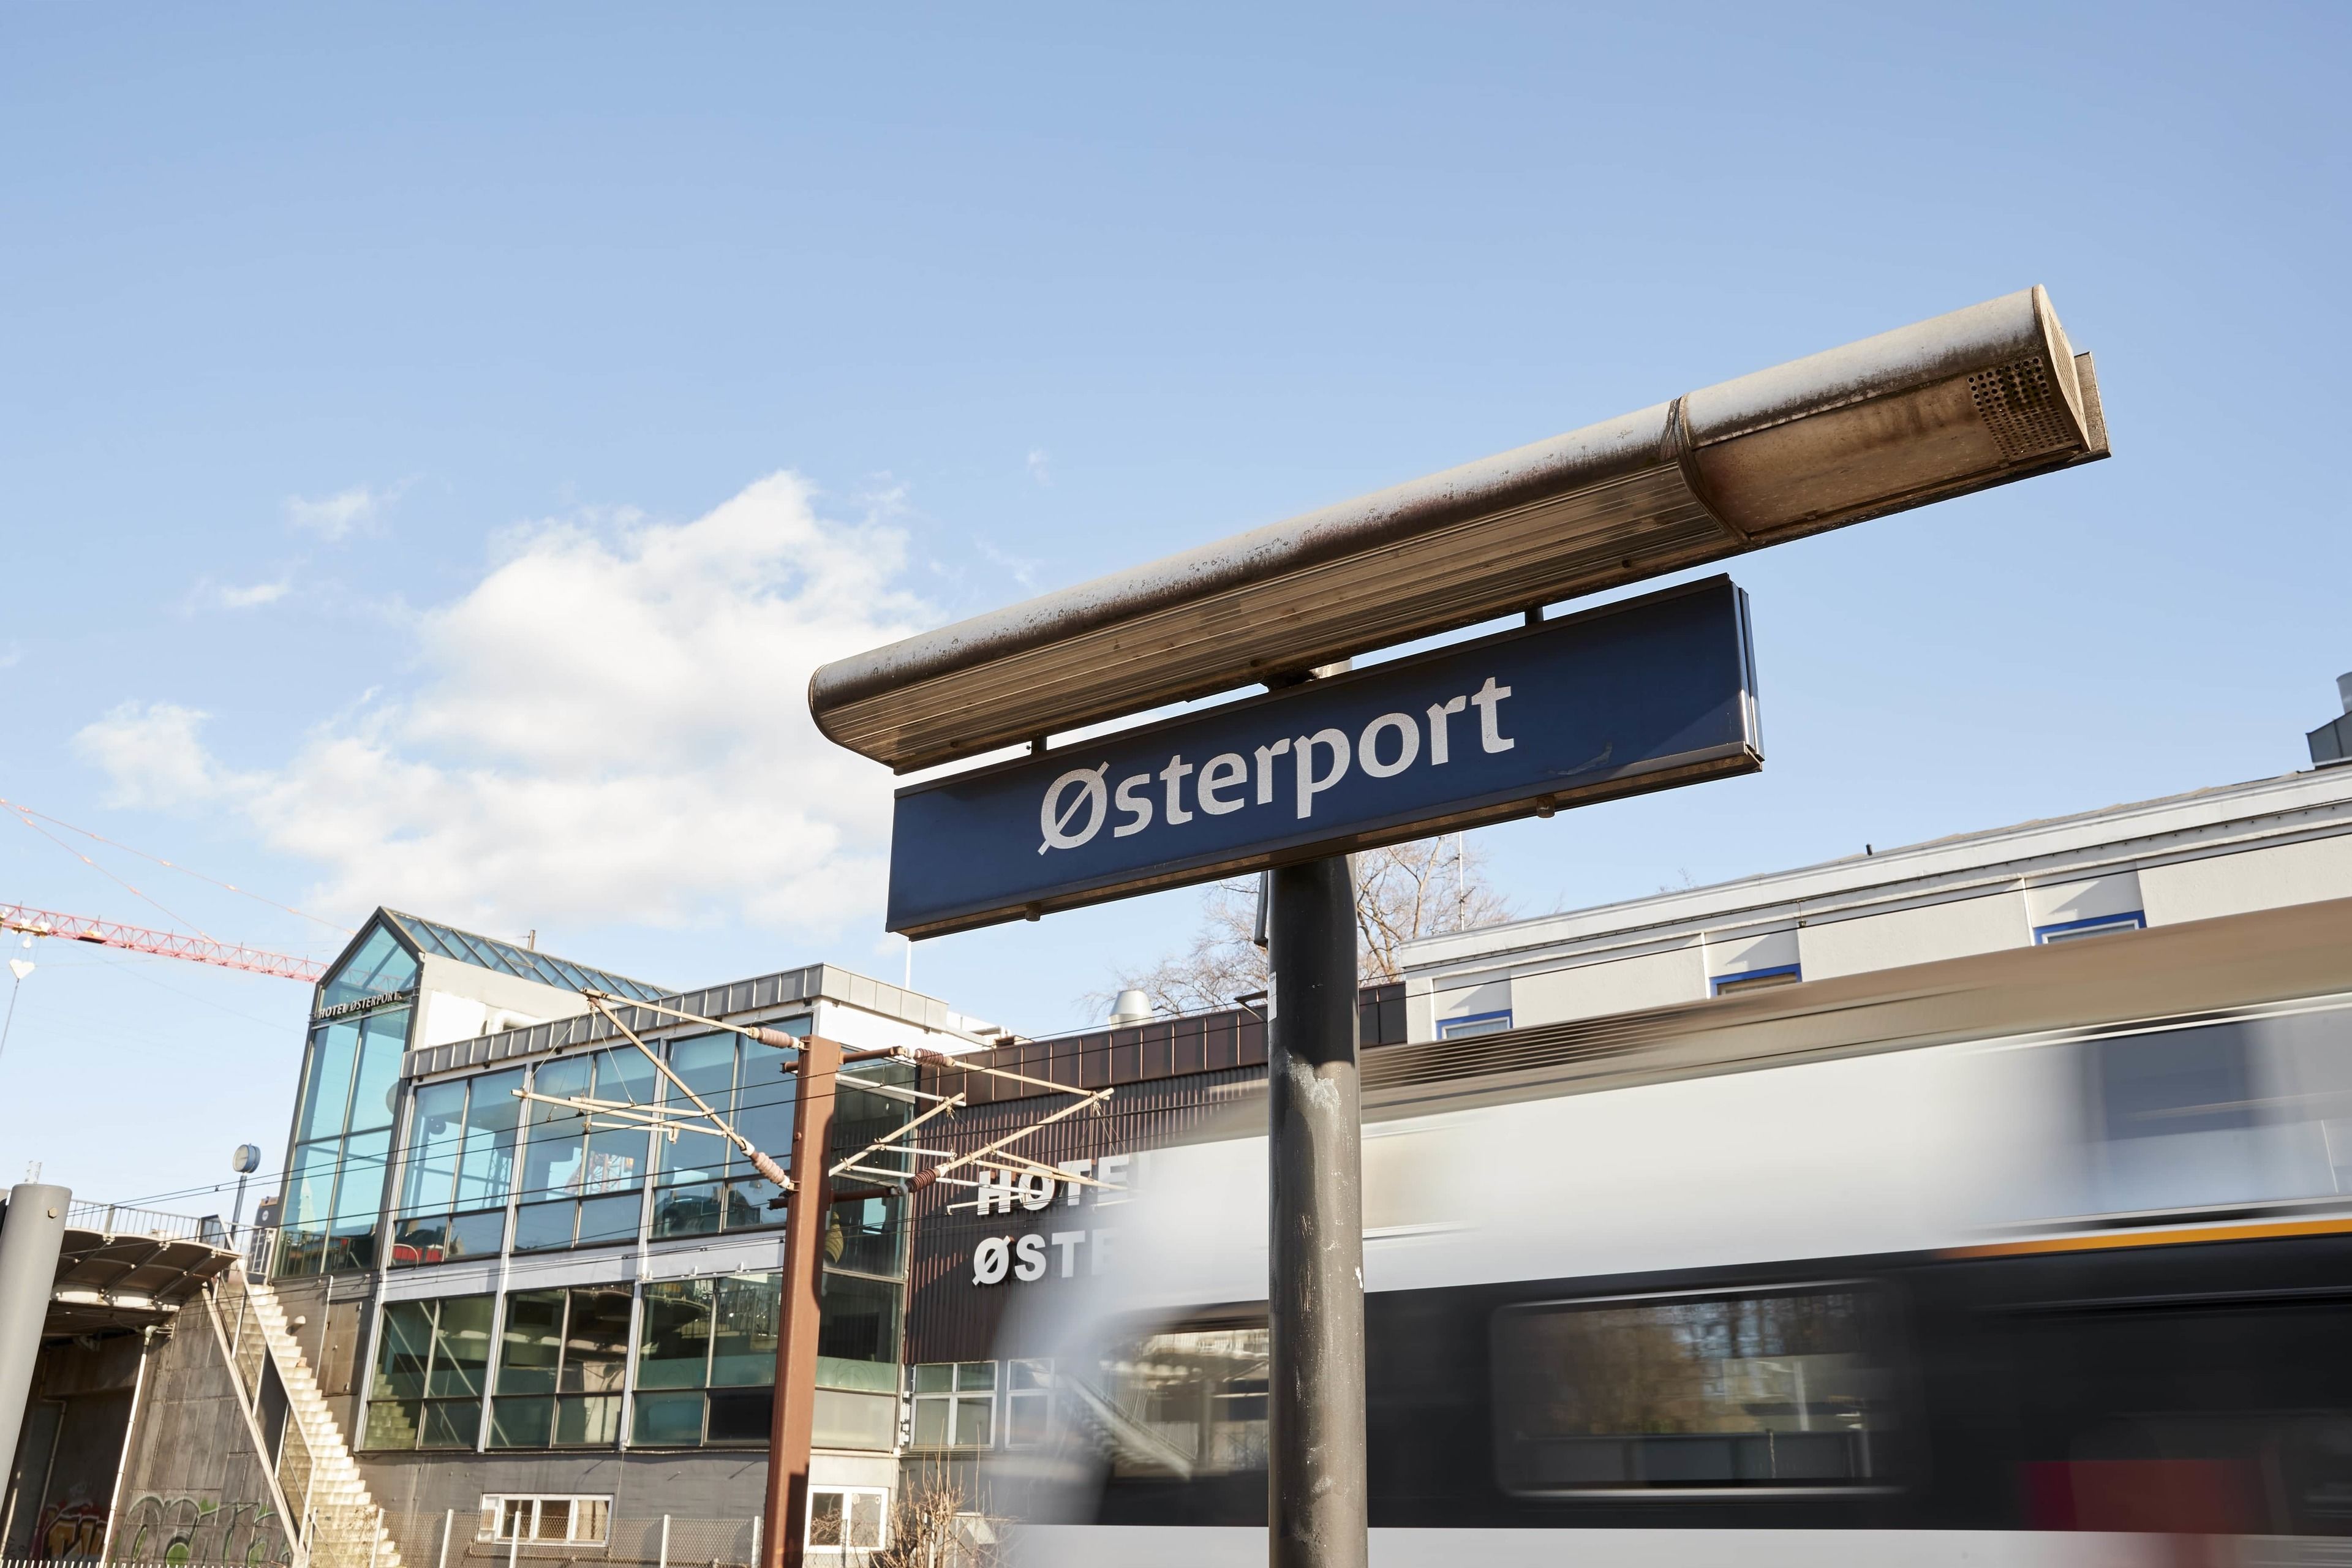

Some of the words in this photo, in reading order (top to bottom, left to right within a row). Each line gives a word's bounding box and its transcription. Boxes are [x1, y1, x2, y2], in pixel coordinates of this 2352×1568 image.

[1038, 677, 1515, 856] Østerport
[318, 1003, 347, 1019] HOTEL
[349, 992, 398, 1012] ØSTERPORT
